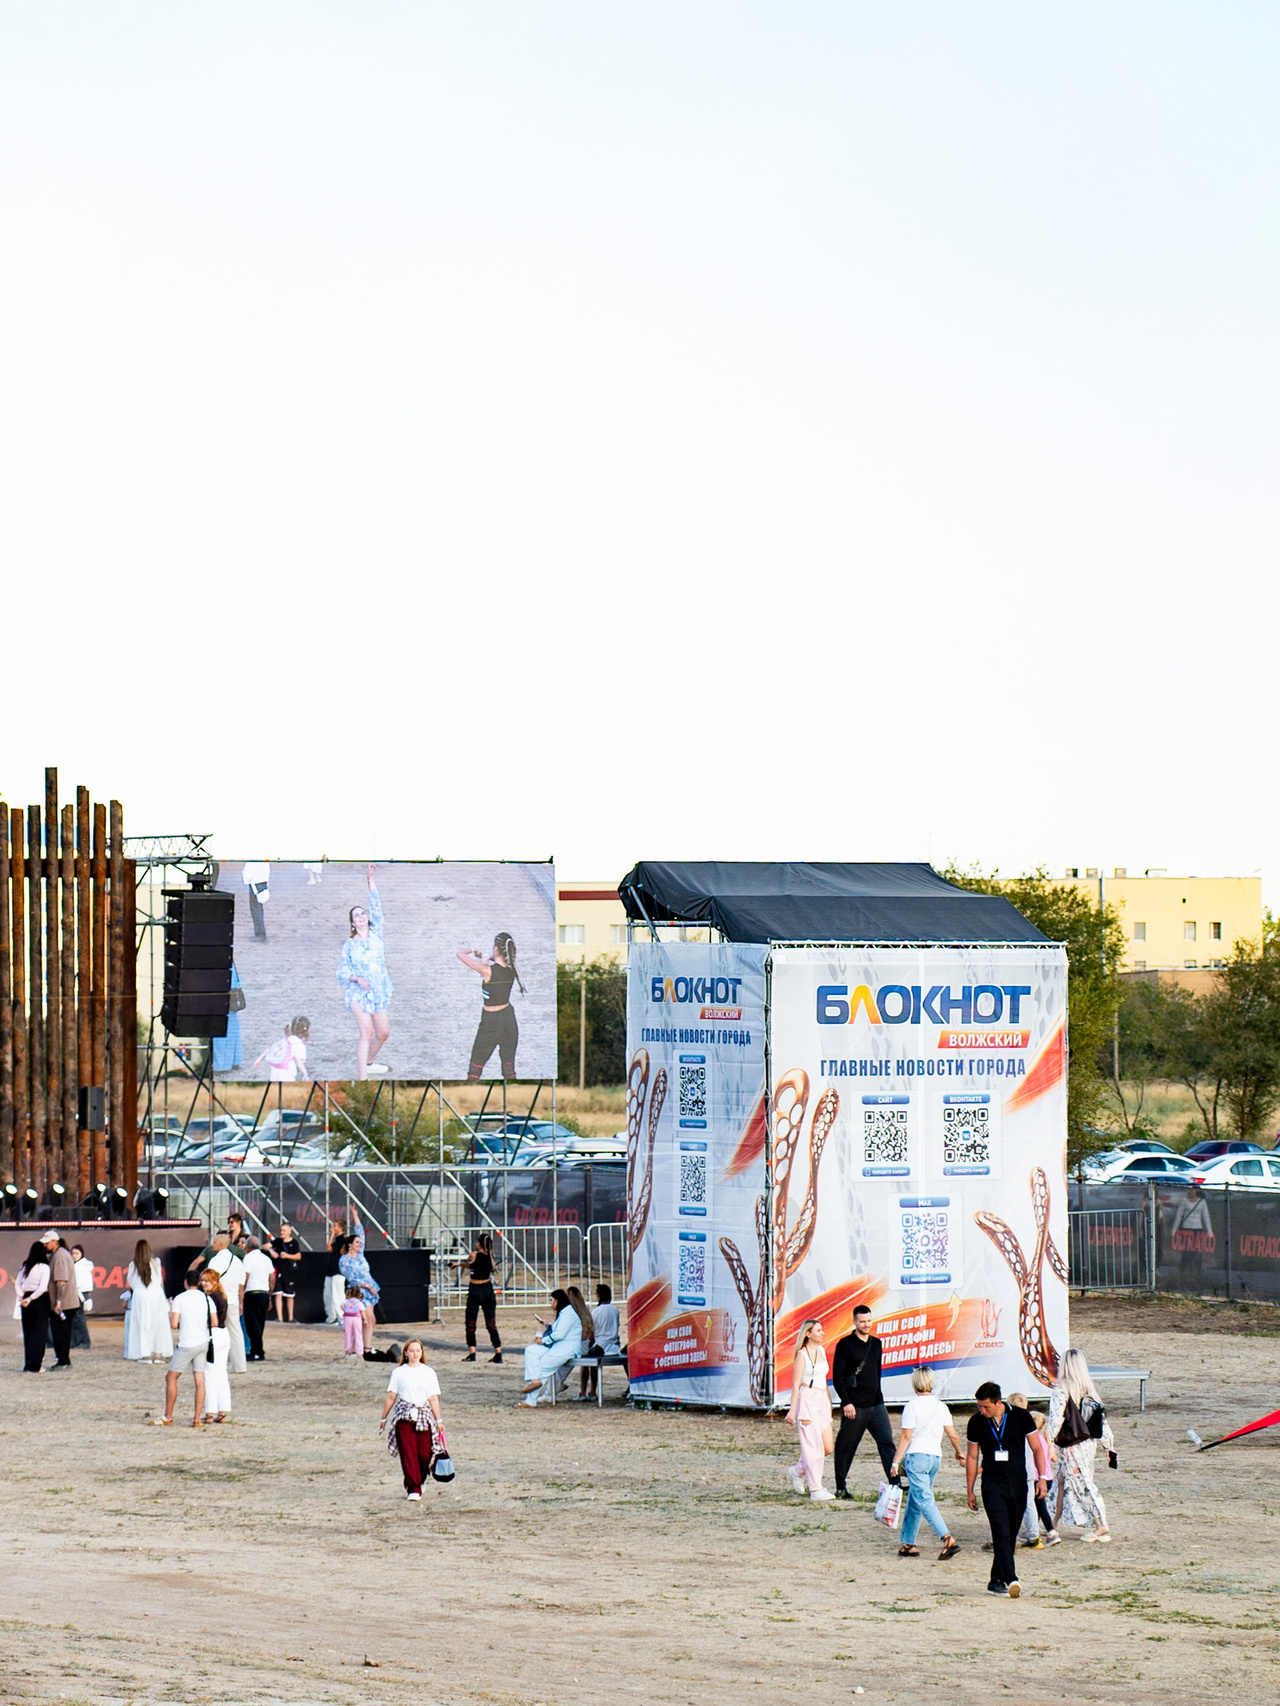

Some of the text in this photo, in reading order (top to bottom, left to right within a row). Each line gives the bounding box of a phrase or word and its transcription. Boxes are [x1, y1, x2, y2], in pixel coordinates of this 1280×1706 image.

[651, 976, 742, 1004] БЛОКНОТ
[704, 1008, 739, 1019] ВОЛЖСКИЙ
[816, 984, 1032, 1025] БЛОКНОТ
[641, 1028, 751, 1046] ГЛАВНЫЕ НОВОСТИ ГОРОДА
[948, 1032, 1023, 1047] ВОЛЖСКИЙ
[820, 1058, 1026, 1078] ГЛАВНЫЕ НОВОСТИ ГОРОДА
[877, 1095, 893, 1104] САЙТ
[877, 1315, 927, 1334] ИЩИ СВОИ
[881, 1341, 955, 1365] ТИВАЛЯ ЗДЕСЬ!
